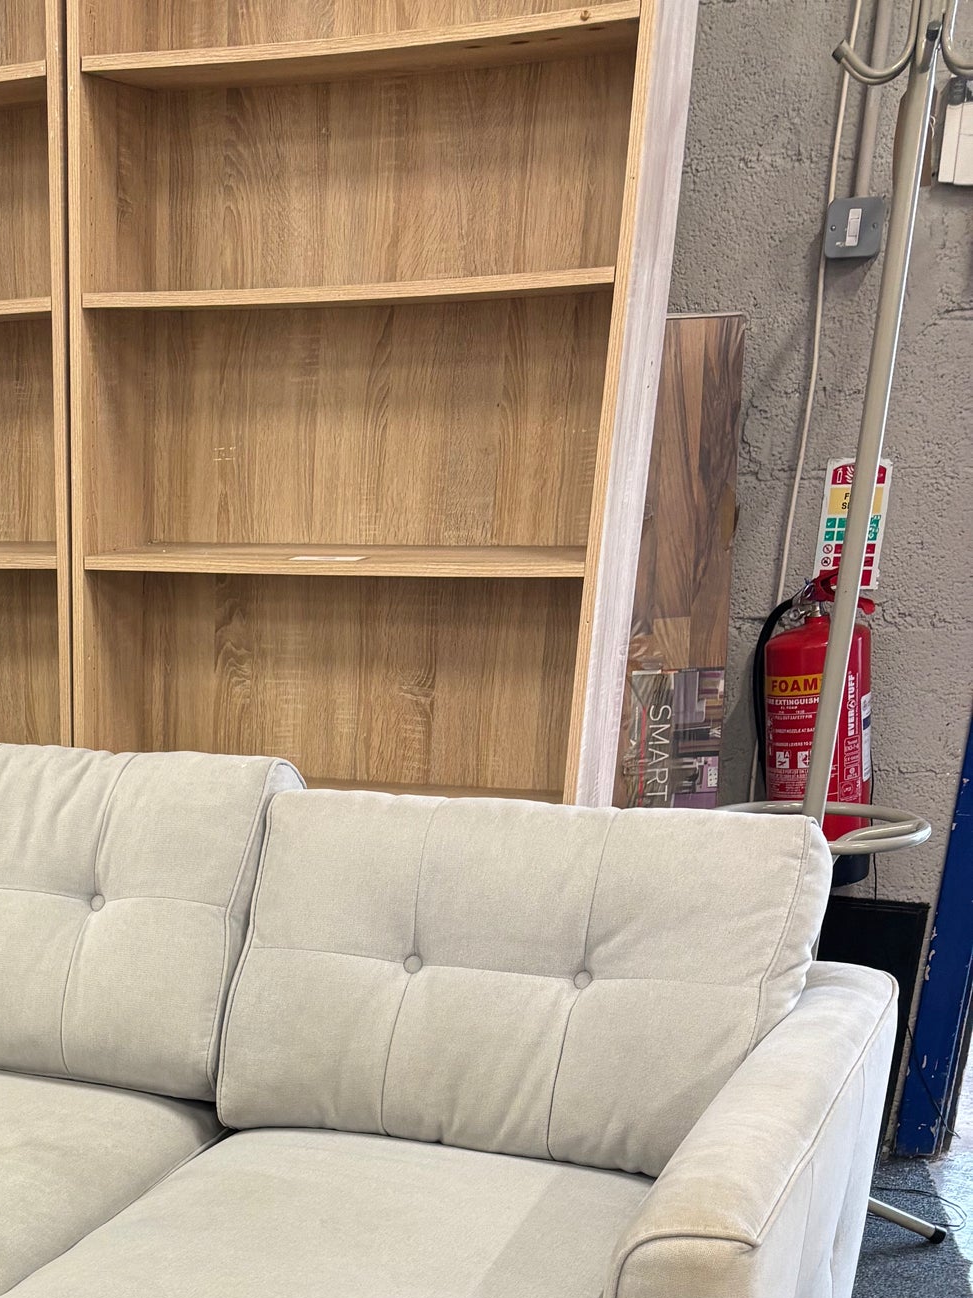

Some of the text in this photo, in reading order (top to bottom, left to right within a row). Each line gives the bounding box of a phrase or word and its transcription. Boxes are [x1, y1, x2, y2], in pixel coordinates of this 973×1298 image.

[771, 677, 818, 692] FOAM
[775, 697, 820, 705] EXTINGUISH
[646, 704, 672, 801] SMART
